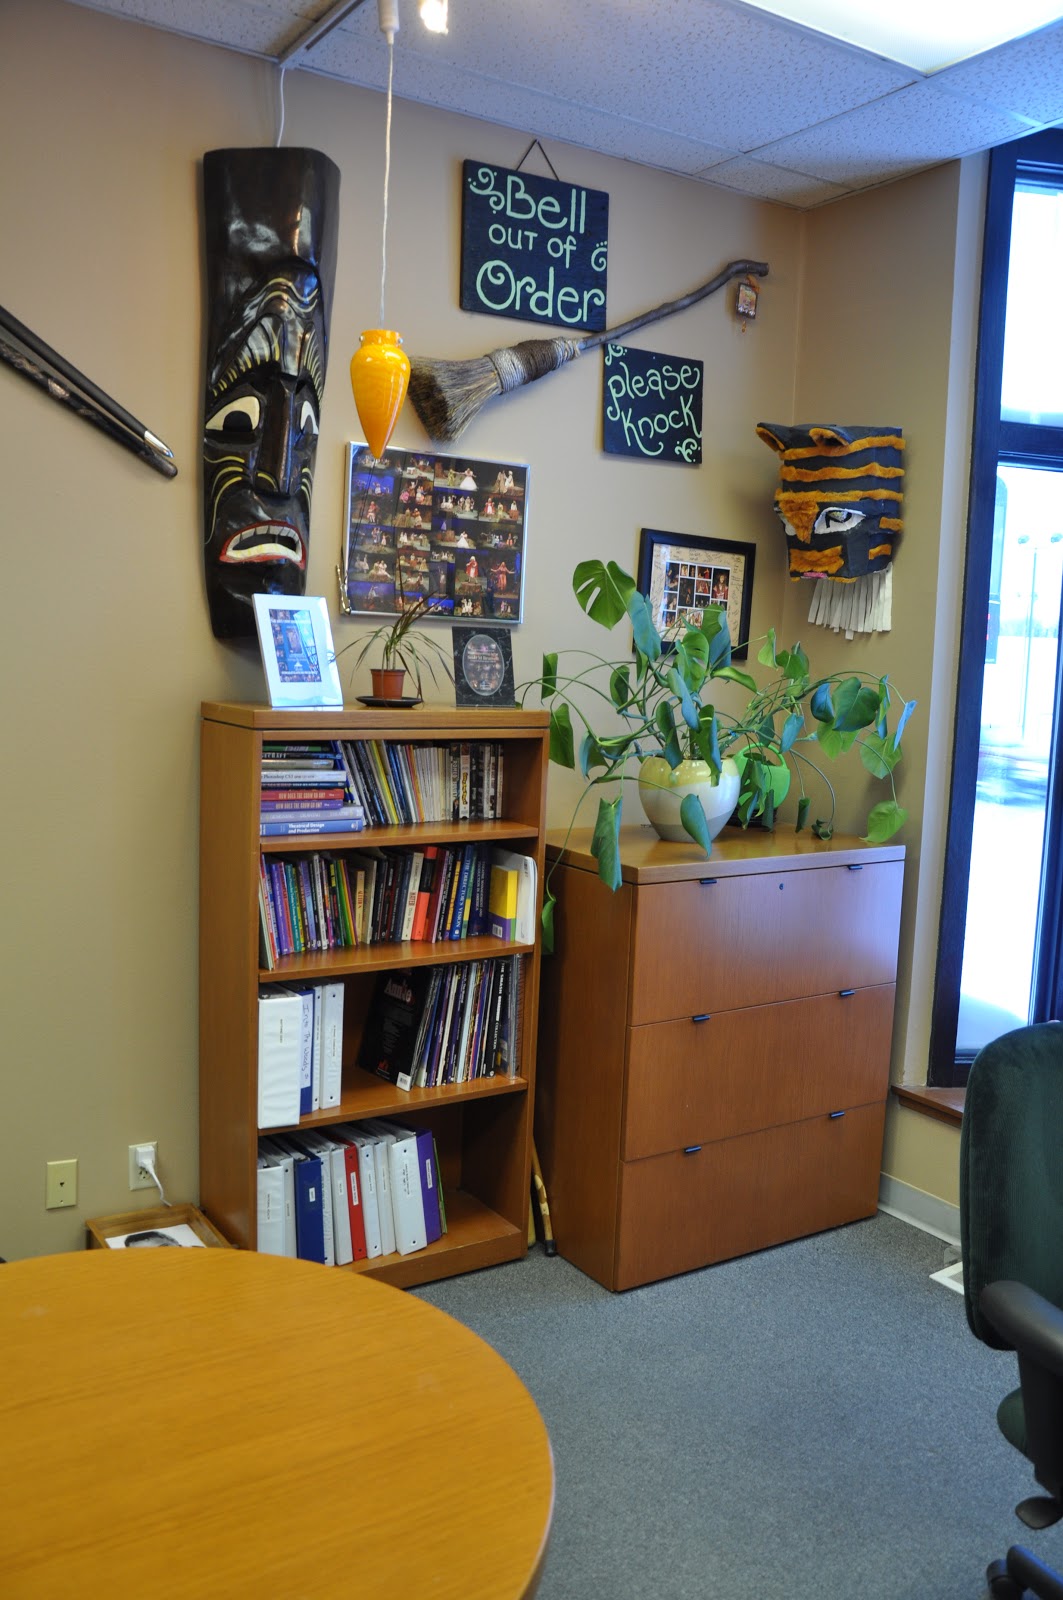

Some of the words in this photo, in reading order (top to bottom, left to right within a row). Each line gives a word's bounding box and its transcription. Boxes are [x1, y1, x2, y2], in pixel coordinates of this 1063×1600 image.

[506, 175, 586, 234] Bell
[547, 235, 577, 269] of
[476, 260, 605, 323] Order
[606, 361, 700, 421] please
[459, 872, 469, 906] DIRECTOR'S
[456, 907, 464, 928] VISION
